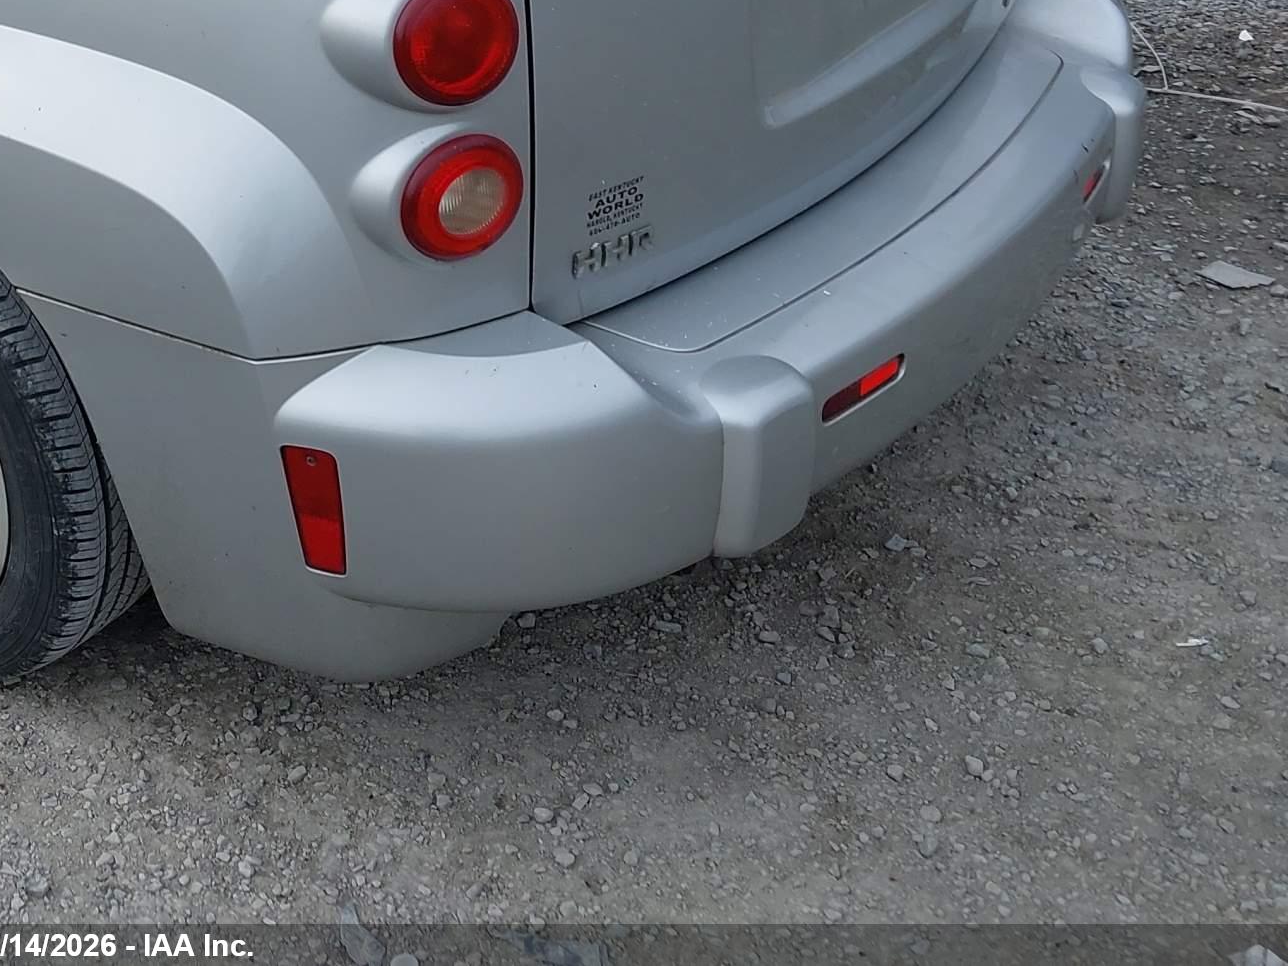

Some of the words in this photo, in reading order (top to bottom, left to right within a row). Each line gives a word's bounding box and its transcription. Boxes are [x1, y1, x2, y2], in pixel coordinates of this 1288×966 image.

[608, 175, 645, 194] KENTUCKY
[587, 193, 644, 220] WORLD
[594, 186, 638, 209] AUTO
[571, 223, 655, 280] HHR
